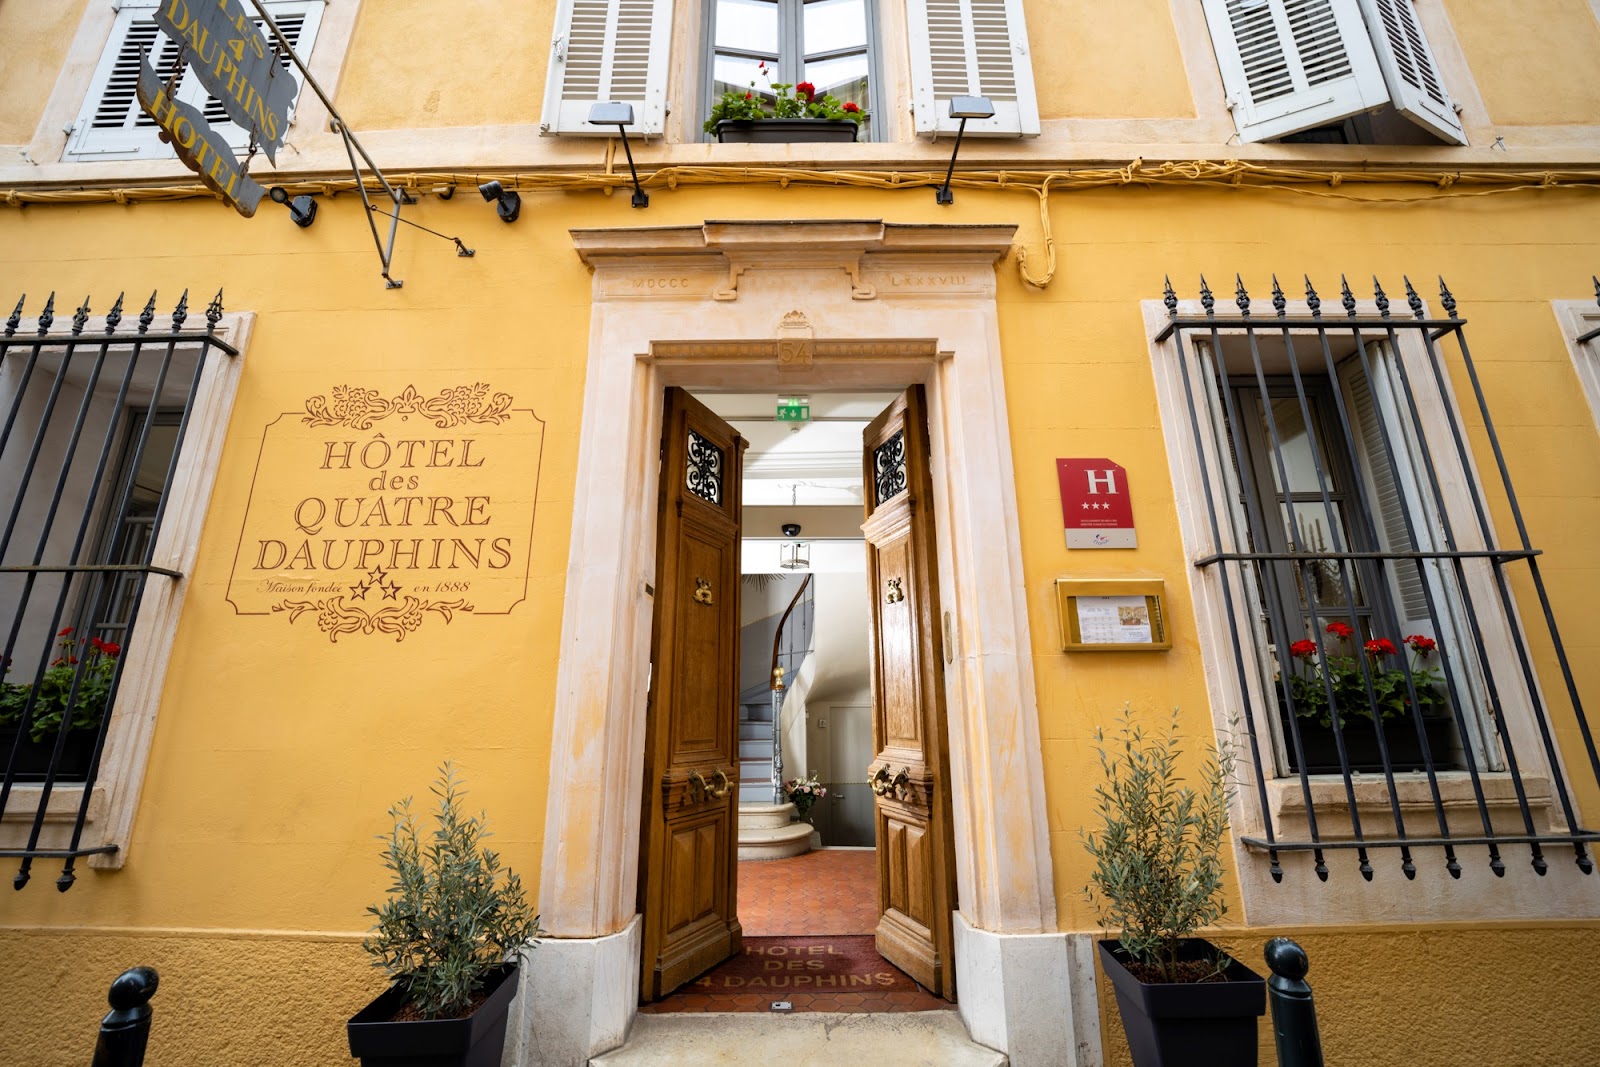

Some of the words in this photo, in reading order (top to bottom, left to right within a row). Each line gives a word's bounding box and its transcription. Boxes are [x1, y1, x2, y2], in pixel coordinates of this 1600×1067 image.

[219, 0, 265, 60] LES
[228, 39, 245, 62] 4
[166, 0, 280, 141] DAUPHINS
[150, 89, 241, 203] HOTEL
[781, 342, 810, 364] 54
[319, 433, 485, 470] HÔTEL
[368, 470, 419, 491] des
[1084, 469, 1119, 494] H
[294, 496, 492, 535] QUATRE
[252, 537, 512, 571] DAUPHINS
[256, 579, 304, 593] Maison
[304, 581, 344, 597] fondée
[413, 585, 430, 593] en
[434, 581, 471, 593] 1888
[745, 944, 844, 956] HOTEL
[764, 960, 825, 971] DES
[695, 975, 713, 988] 4
[723, 973, 896, 988] DAUPHINS
